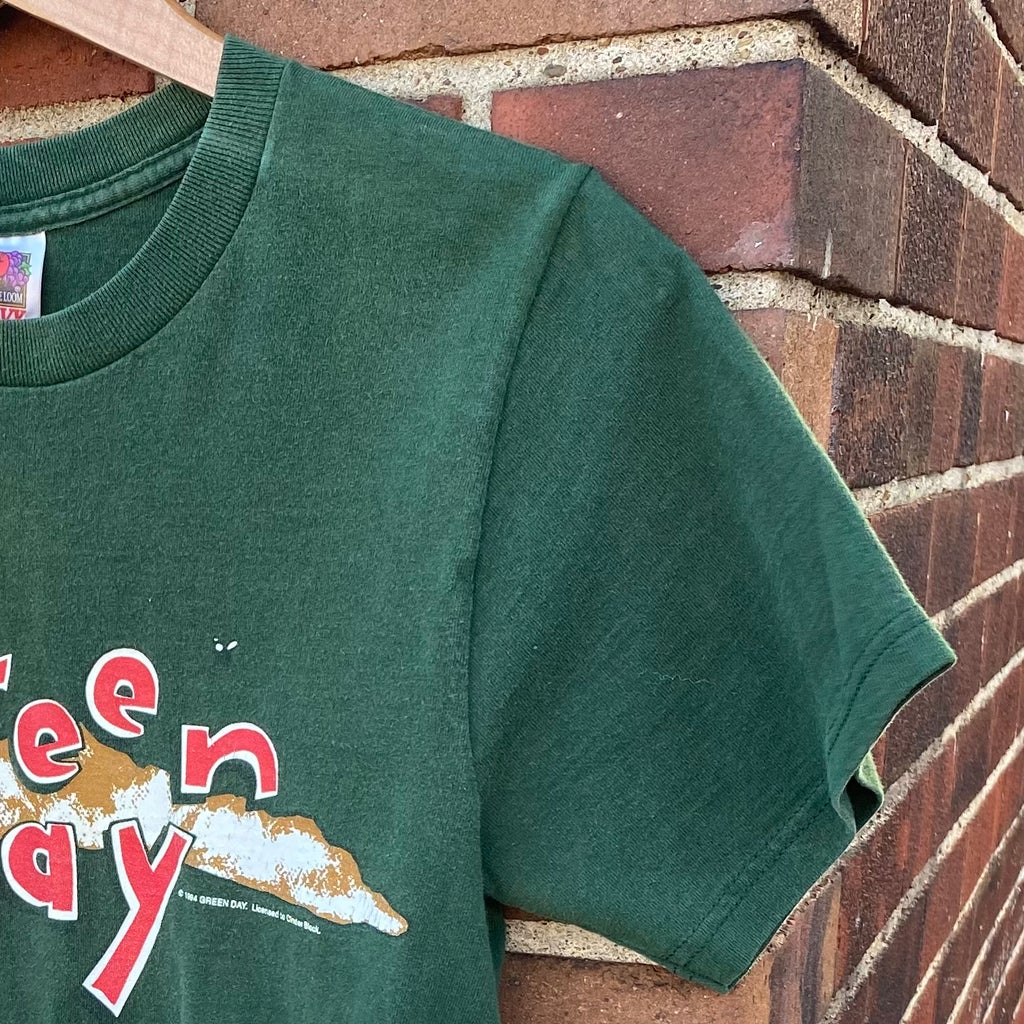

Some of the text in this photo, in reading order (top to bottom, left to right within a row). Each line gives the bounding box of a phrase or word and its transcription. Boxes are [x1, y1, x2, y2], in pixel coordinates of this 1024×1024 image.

[4, 291, 23, 304] LOOM
[199, 895, 229, 907] GREEN
[230, 899, 248, 910] DAY.
[251, 903, 280, 919] Licensed
[279, 912, 286, 921] to
[286, 913, 304, 928] Cinder
